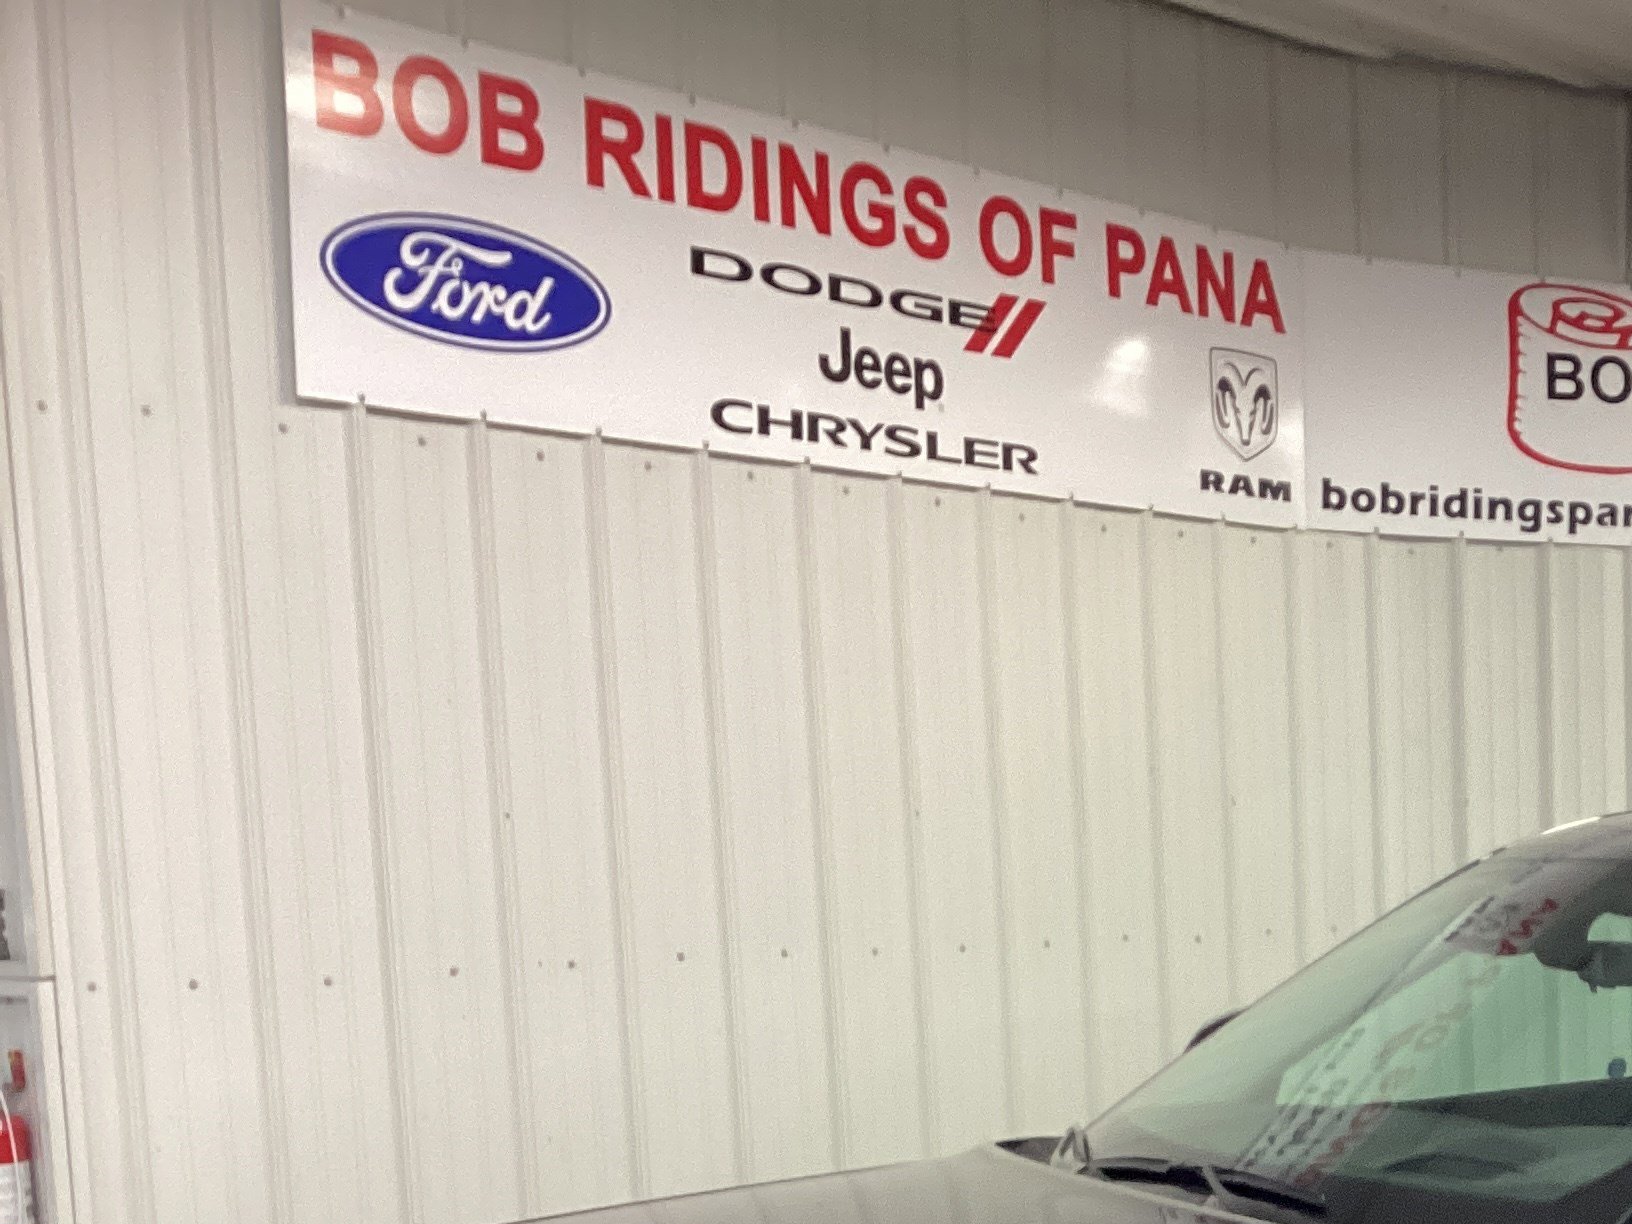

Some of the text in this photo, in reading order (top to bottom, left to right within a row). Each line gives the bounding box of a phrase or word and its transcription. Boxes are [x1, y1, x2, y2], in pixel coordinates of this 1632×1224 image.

[311, 28, 1287, 335] BOB RIDINGS OF PANA
[383, 230, 555, 335] Ford
[690, 245, 1000, 334] DODGE
[818, 326, 944, 411] Jeep
[710, 398, 1040, 475] CHRYSLER
[1200, 468, 1292, 502] RAM
